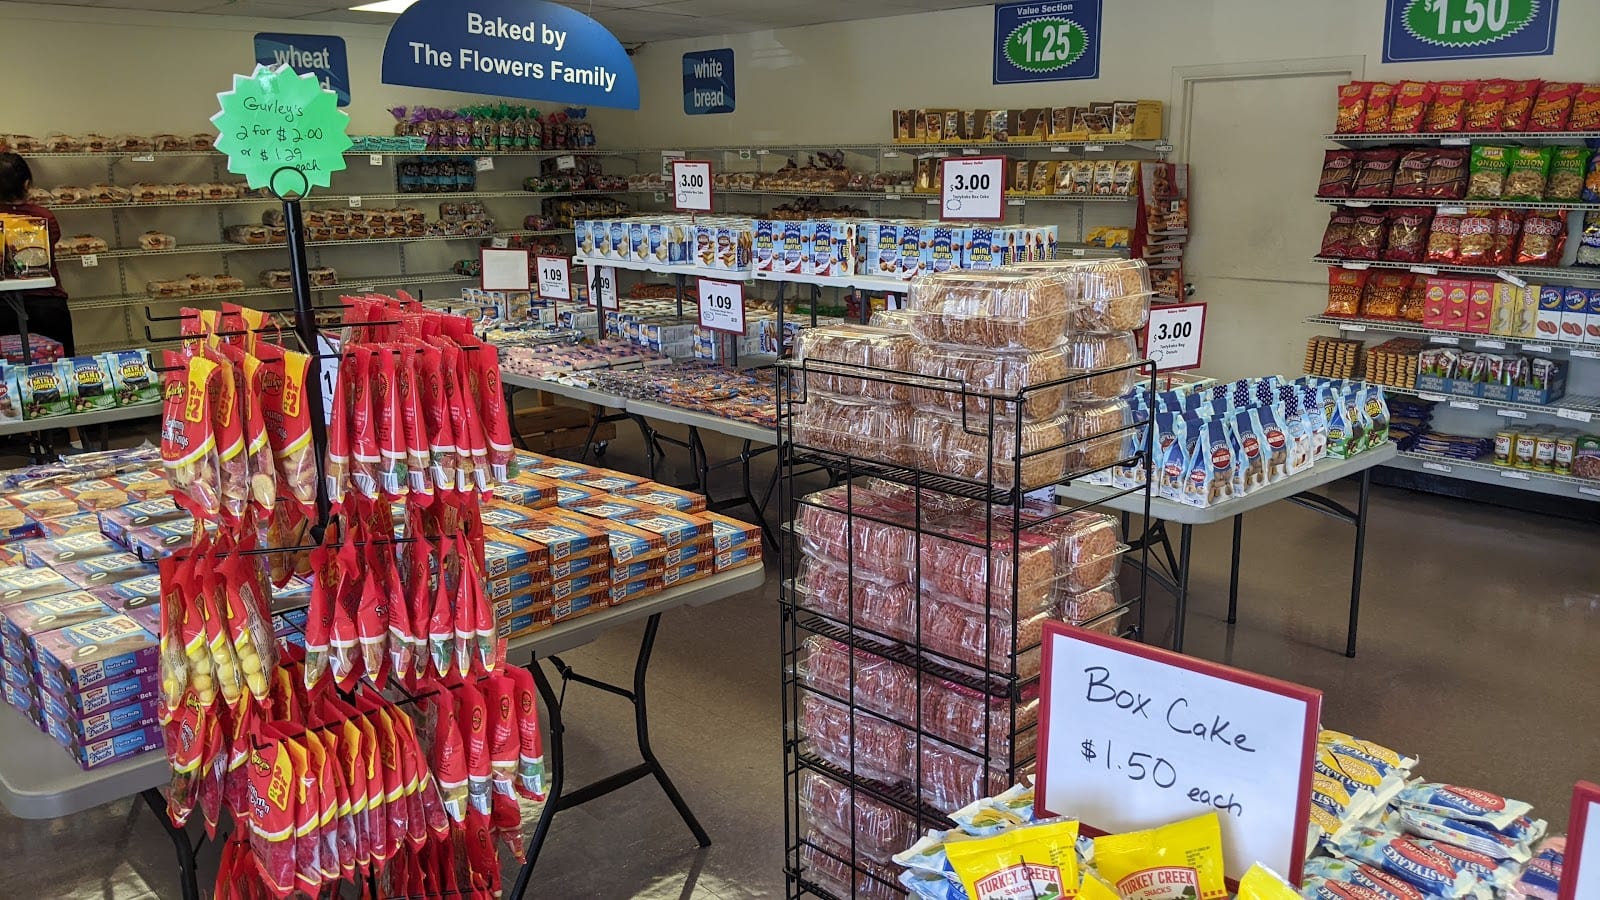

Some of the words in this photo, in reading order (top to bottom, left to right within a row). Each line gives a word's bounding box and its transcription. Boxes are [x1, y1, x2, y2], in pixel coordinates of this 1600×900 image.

[1016, 7, 1040, 16] Value
[1041, 3, 1073, 13] Section
[1424, 0, 1510, 34] $1.50
[467, 12, 535, 42] Baked
[541, 23, 567, 51] by
[1017, 24, 1071, 62] $1.25
[273, 46, 330, 71] wheat
[408, 41, 452, 68] The
[459, 49, 544, 79] Flowers
[551, 61, 616, 92] Family
[693, 58, 723, 78] white
[693, 86, 724, 107] bread
[243, 96, 304, 123] Gurley's
[236, 126, 248, 140] 2
[252, 124, 272, 136] for
[241, 148, 251, 157] or
[295, 160, 321, 172] each
[1477, 160, 1505, 168] ONION
[950, 174, 990, 192] $3.00
[543, 268, 562, 281] 1.09
[707, 294, 732, 310] 1.09
[1153, 321, 1192, 343] $3.00
[1084, 666, 1152, 719] Box
[1166, 697, 1256, 753] Cake
[1081, 738, 1177, 789] $1.50
[1186, 786, 1243, 817] each
[1383, 844, 1454, 887] TASTYKAKE
[979, 869, 1018, 895] TURKEY
[1021, 867, 1057, 883] CREEK
[1121, 872, 1154, 896] TURKEY
[1158, 870, 1194, 884] CREEK
[1143, 886, 1172, 897] SNACKS
